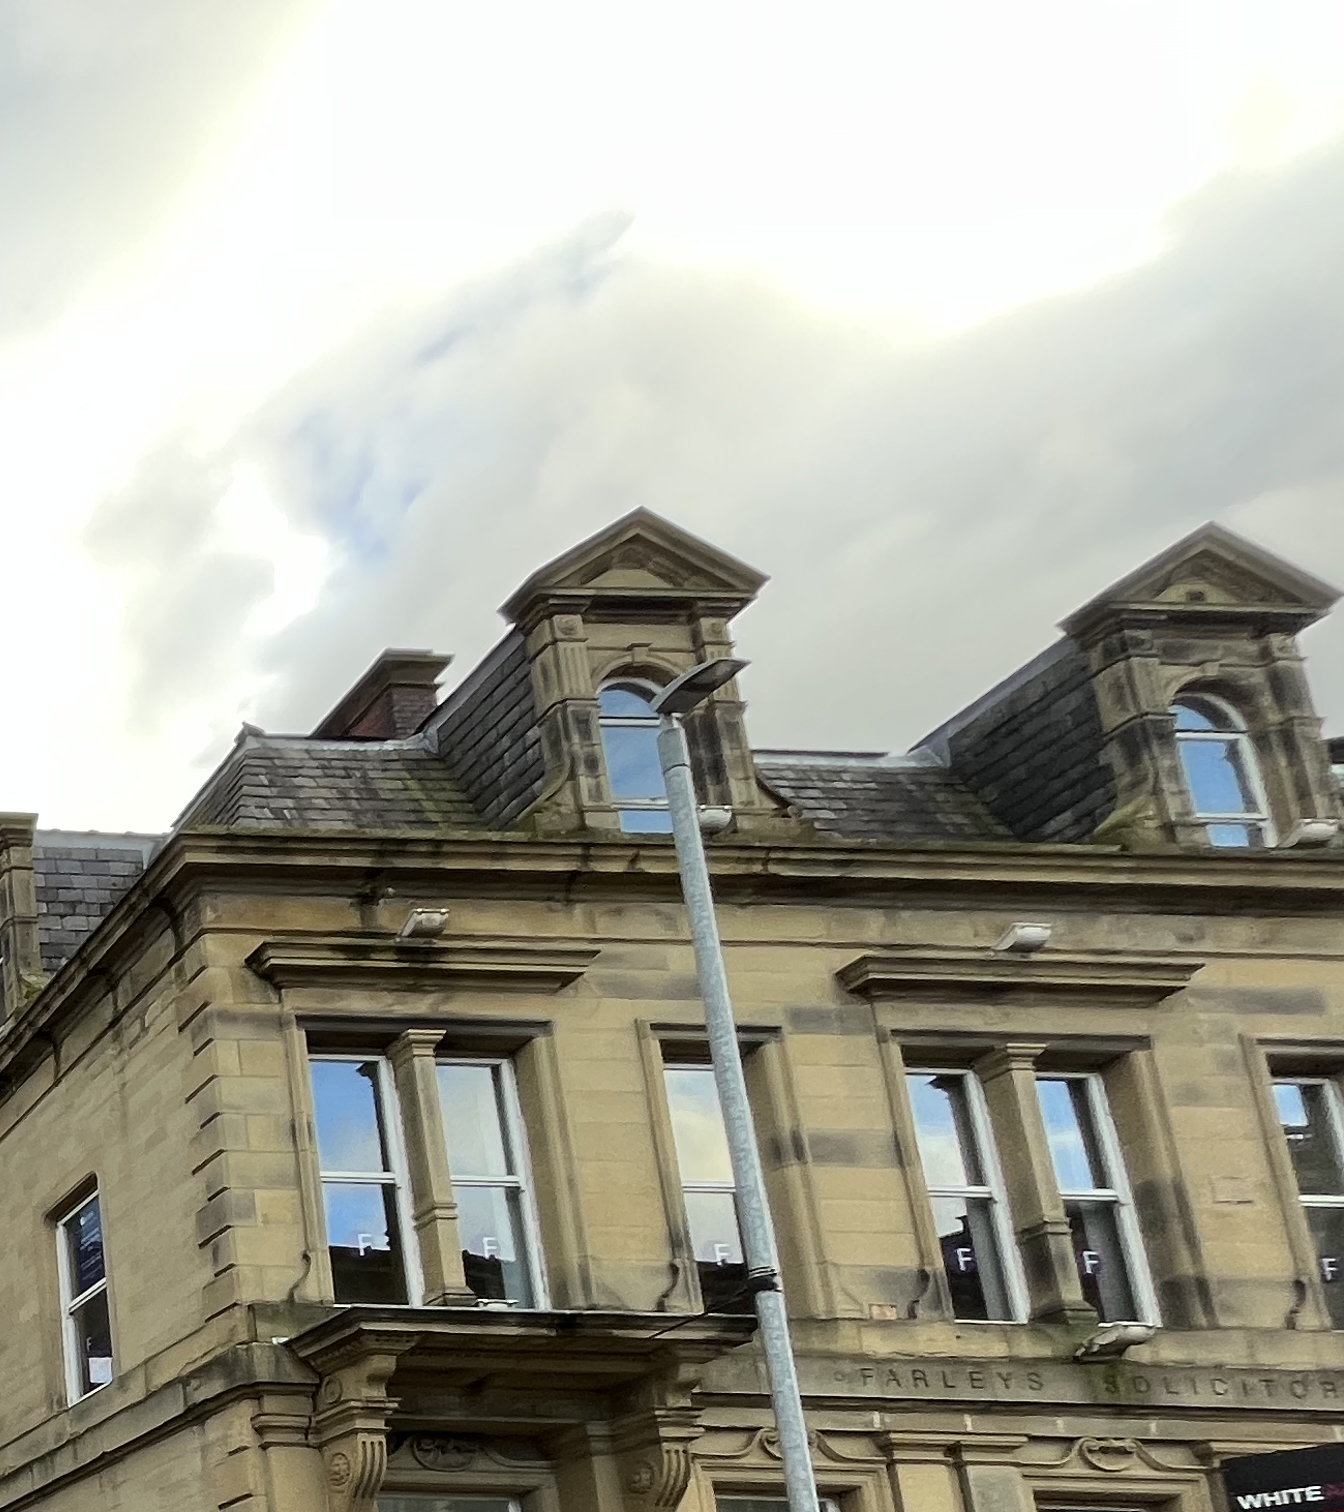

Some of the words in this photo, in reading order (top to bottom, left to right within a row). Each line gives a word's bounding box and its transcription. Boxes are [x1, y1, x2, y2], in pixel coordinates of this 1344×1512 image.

[956, 1248, 973, 1271] F
[1082, 1250, 1099, 1274] F
[1322, 1257, 1338, 1281] F
[860, 1367, 1044, 1391] FARLEYS
